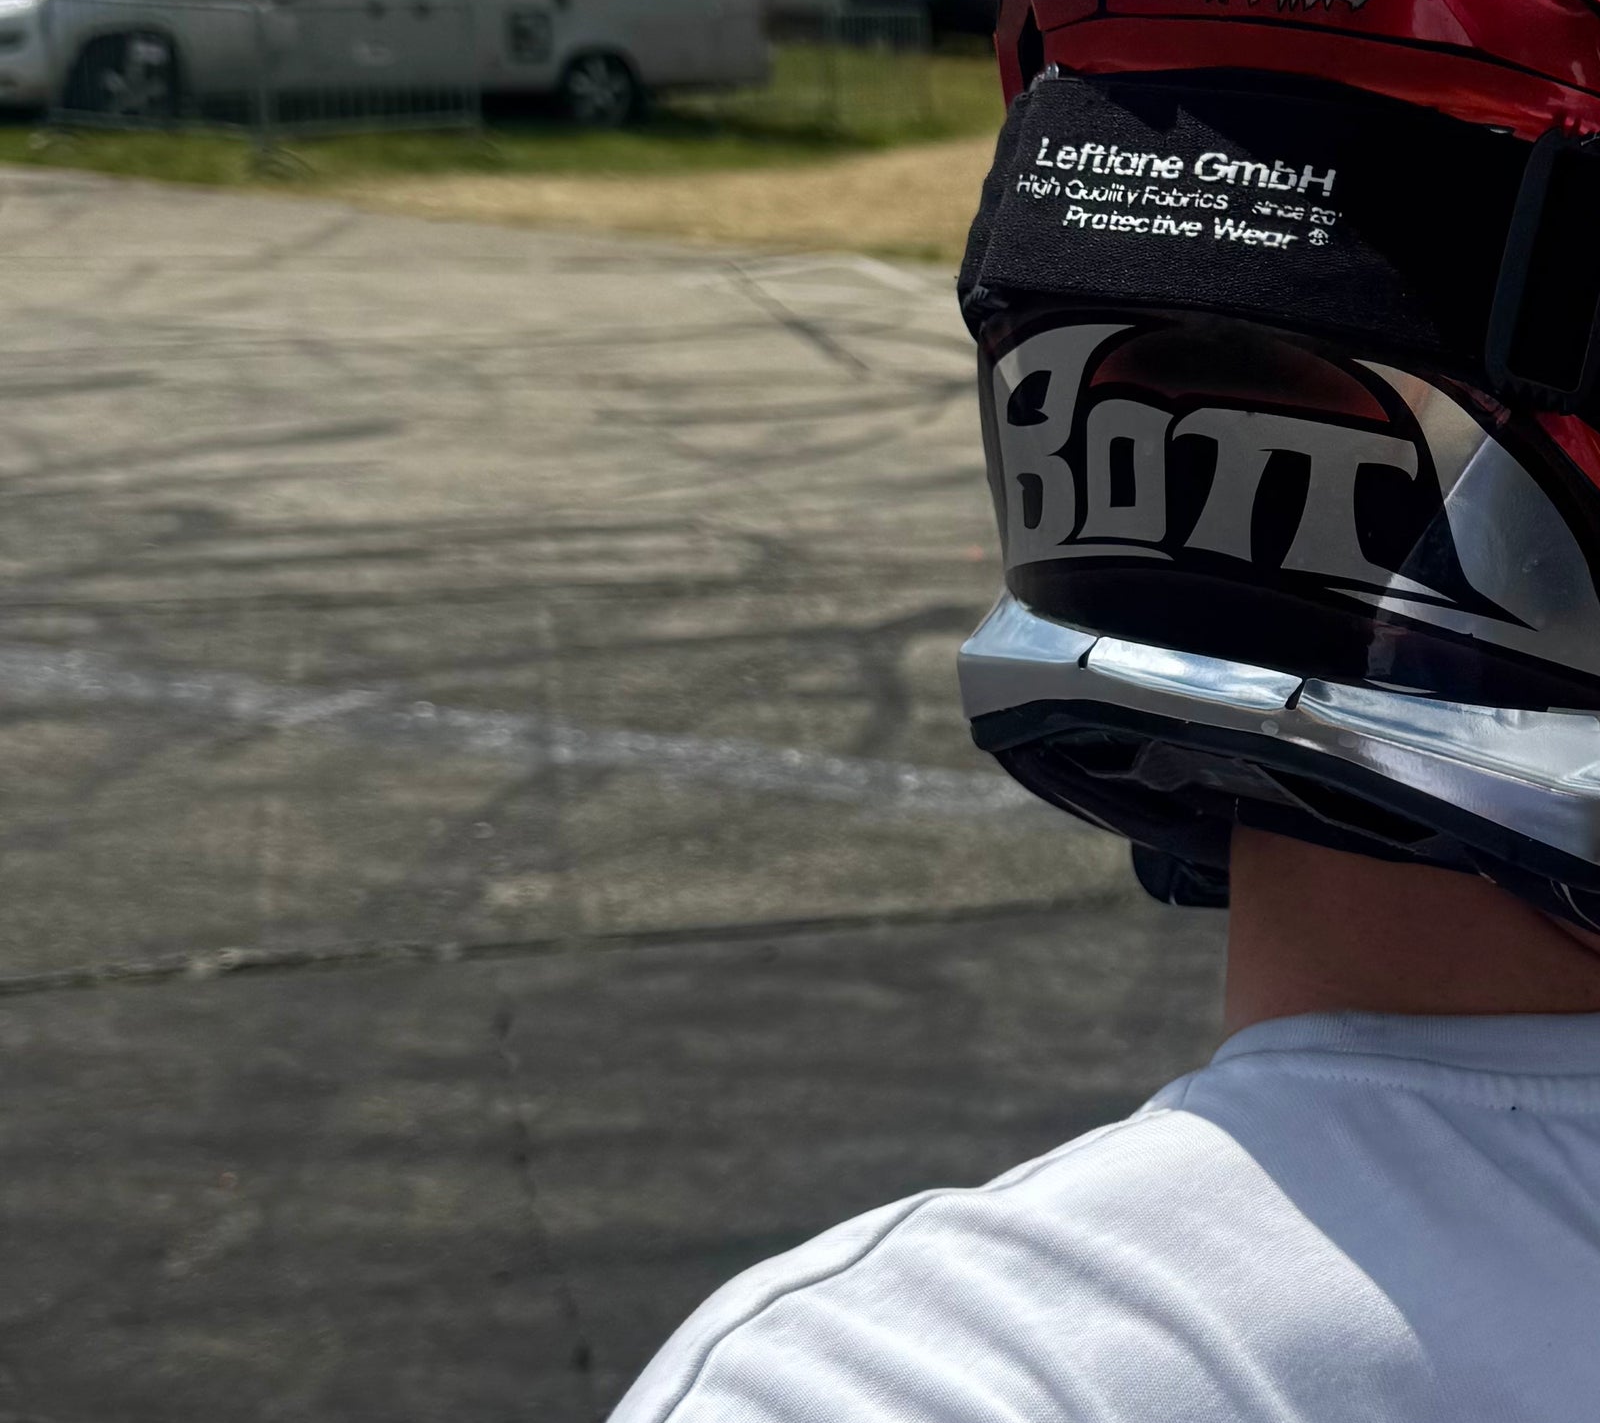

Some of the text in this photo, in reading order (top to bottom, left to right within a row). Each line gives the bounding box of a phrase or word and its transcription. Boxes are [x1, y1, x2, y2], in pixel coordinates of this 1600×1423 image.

[1036, 137, 1336, 196] Leftlane GmbH
[1017, 174, 1061, 199] High
[1142, 186, 1229, 210] Fabrics
[1062, 205, 1299, 249] Protective Wear
